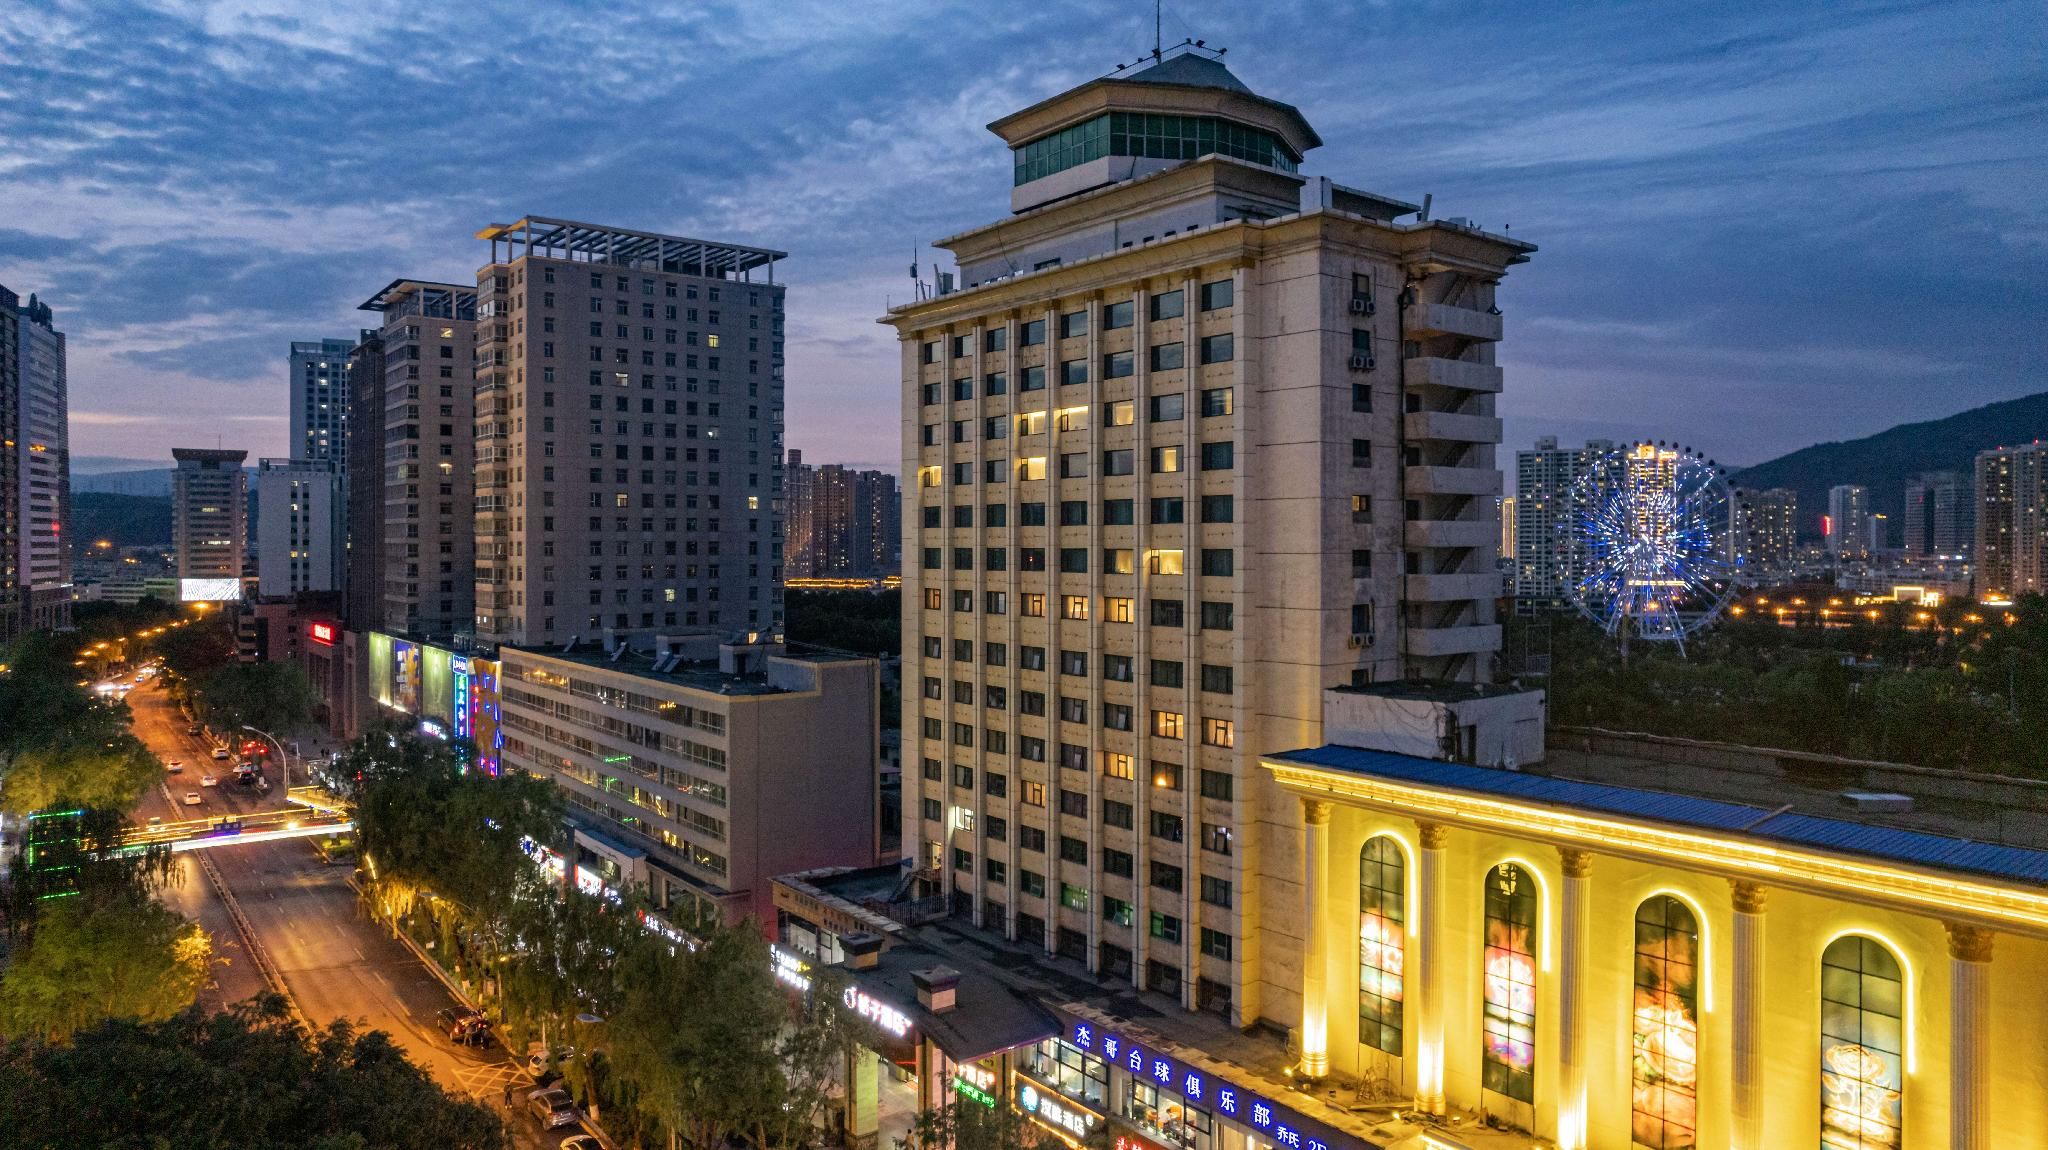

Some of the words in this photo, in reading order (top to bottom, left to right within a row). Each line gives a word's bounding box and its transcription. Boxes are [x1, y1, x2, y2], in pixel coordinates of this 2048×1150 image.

[1076, 1026, 1270, 1127] 杰哥台球俱乐部
[1276, 1125, 1300, 1149] 乔氏
